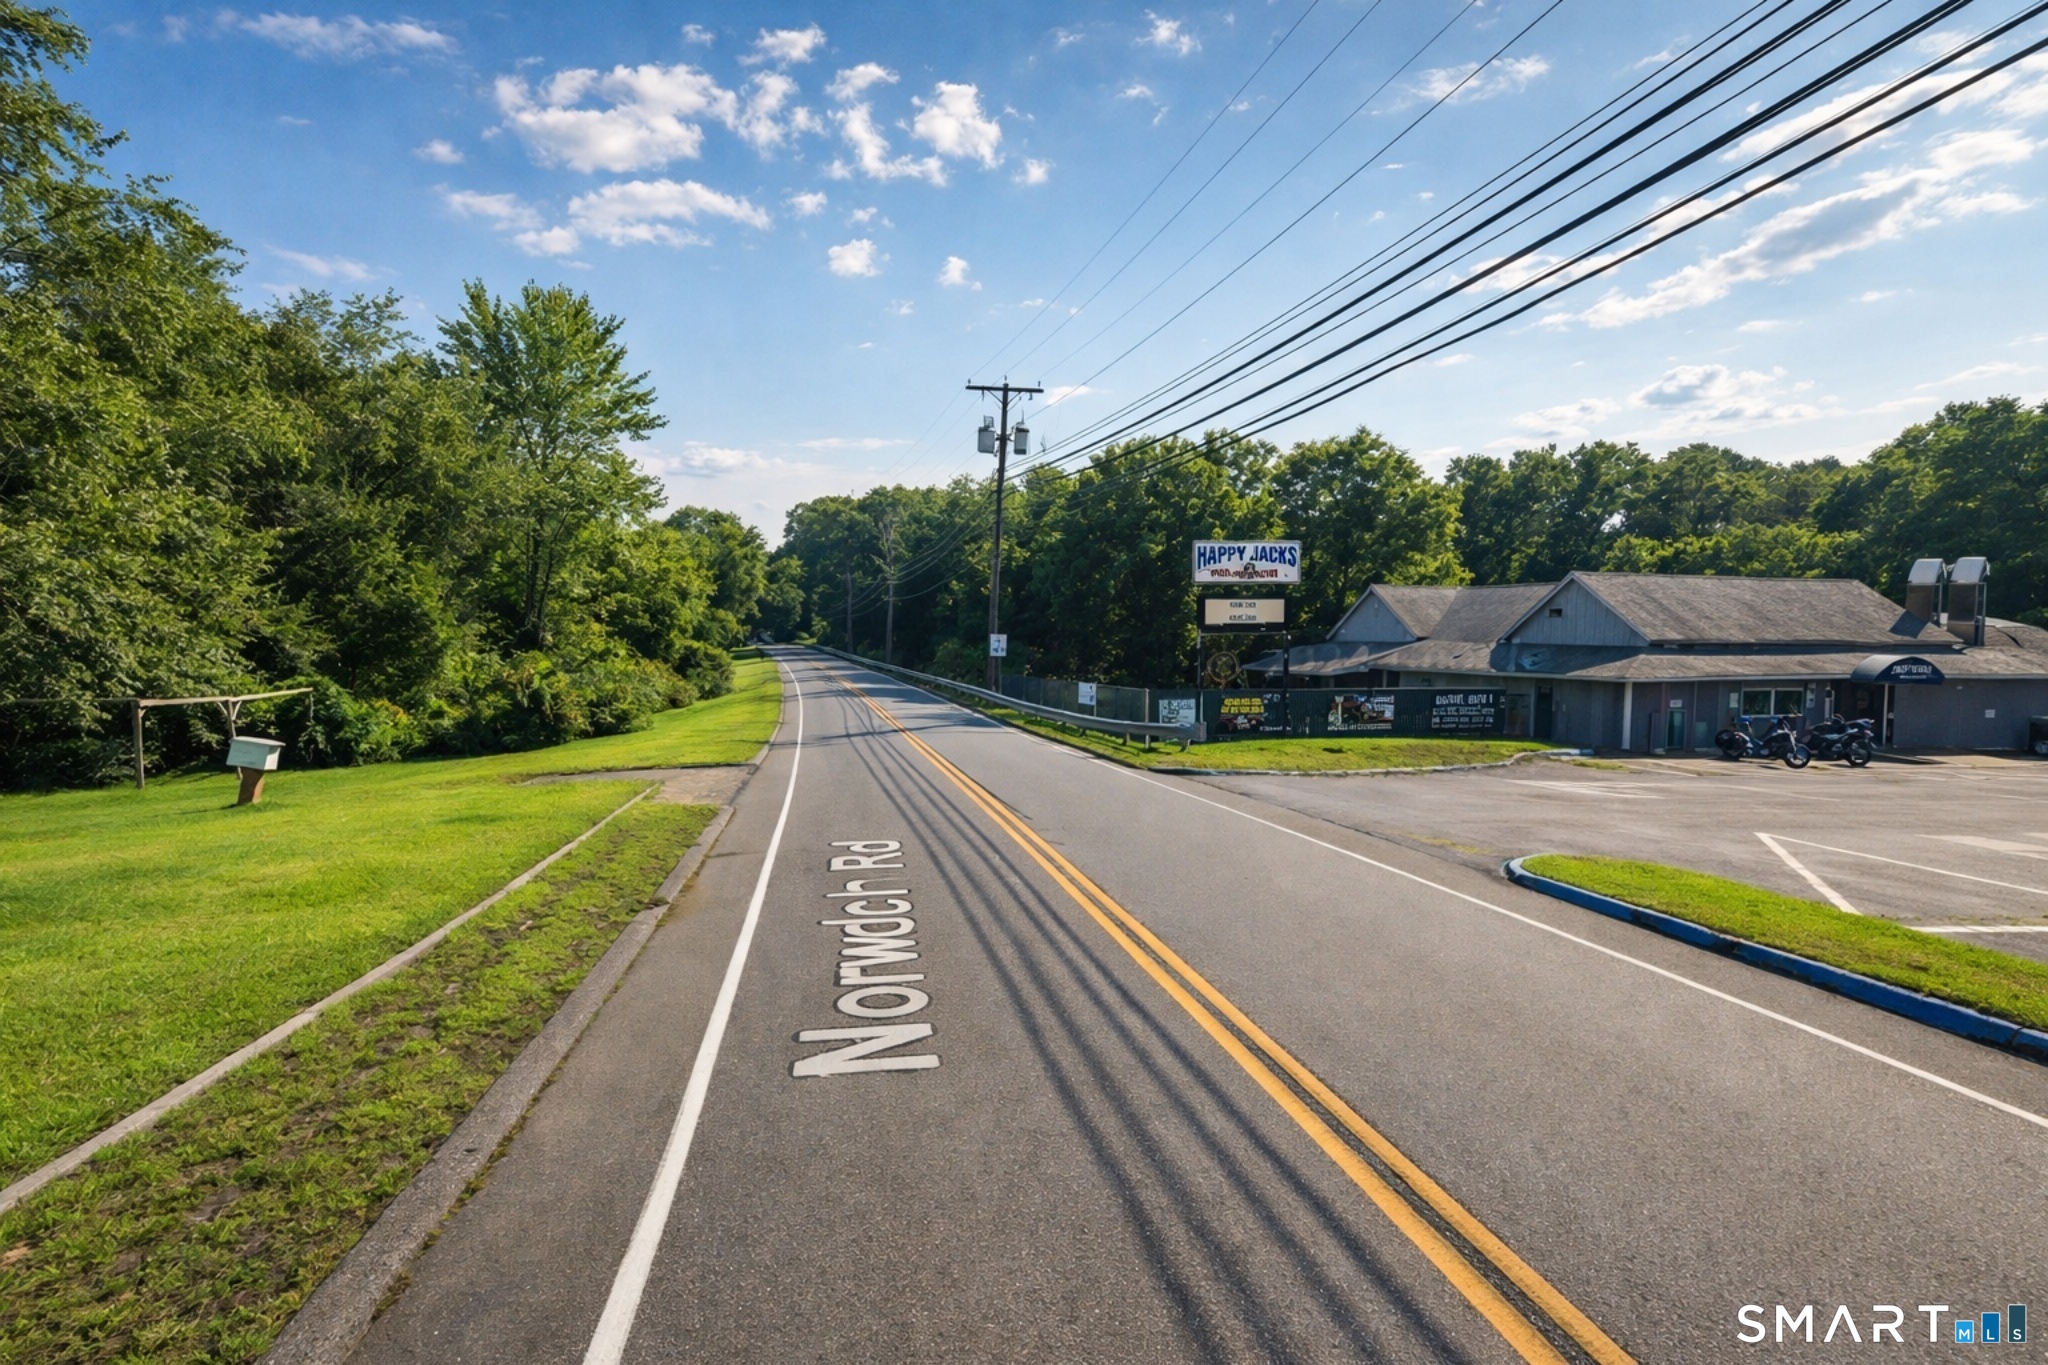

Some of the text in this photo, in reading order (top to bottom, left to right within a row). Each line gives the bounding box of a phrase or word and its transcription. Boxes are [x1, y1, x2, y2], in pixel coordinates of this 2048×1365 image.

[1197, 545, 1297, 570] HAPPY JACKS
[829, 840, 905, 871] Rd
